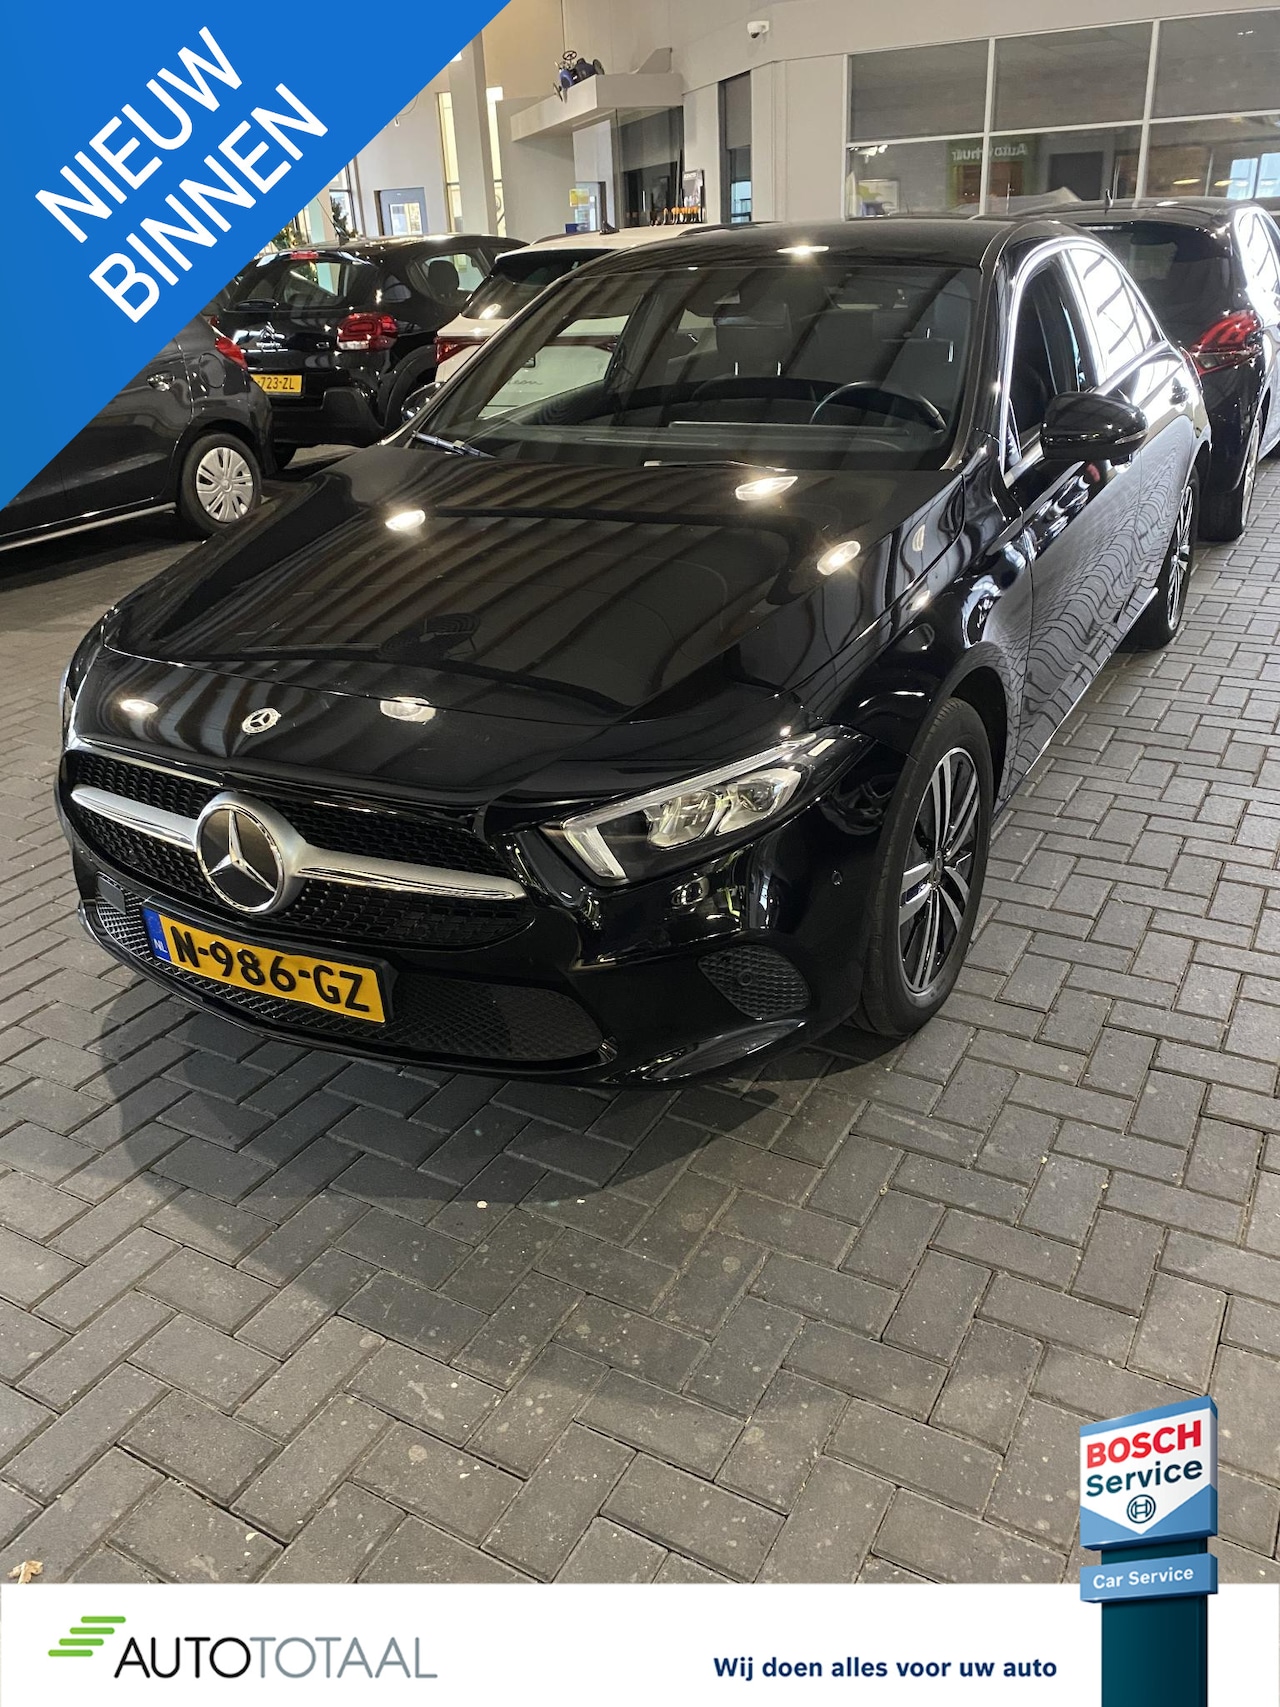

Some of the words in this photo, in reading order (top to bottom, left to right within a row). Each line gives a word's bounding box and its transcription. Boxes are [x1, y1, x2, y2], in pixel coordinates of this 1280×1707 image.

[257, 376, 295, 390] -723-ZL
[153, 938, 168, 953] NL
[170, 925, 370, 1013] N-986-GZ
